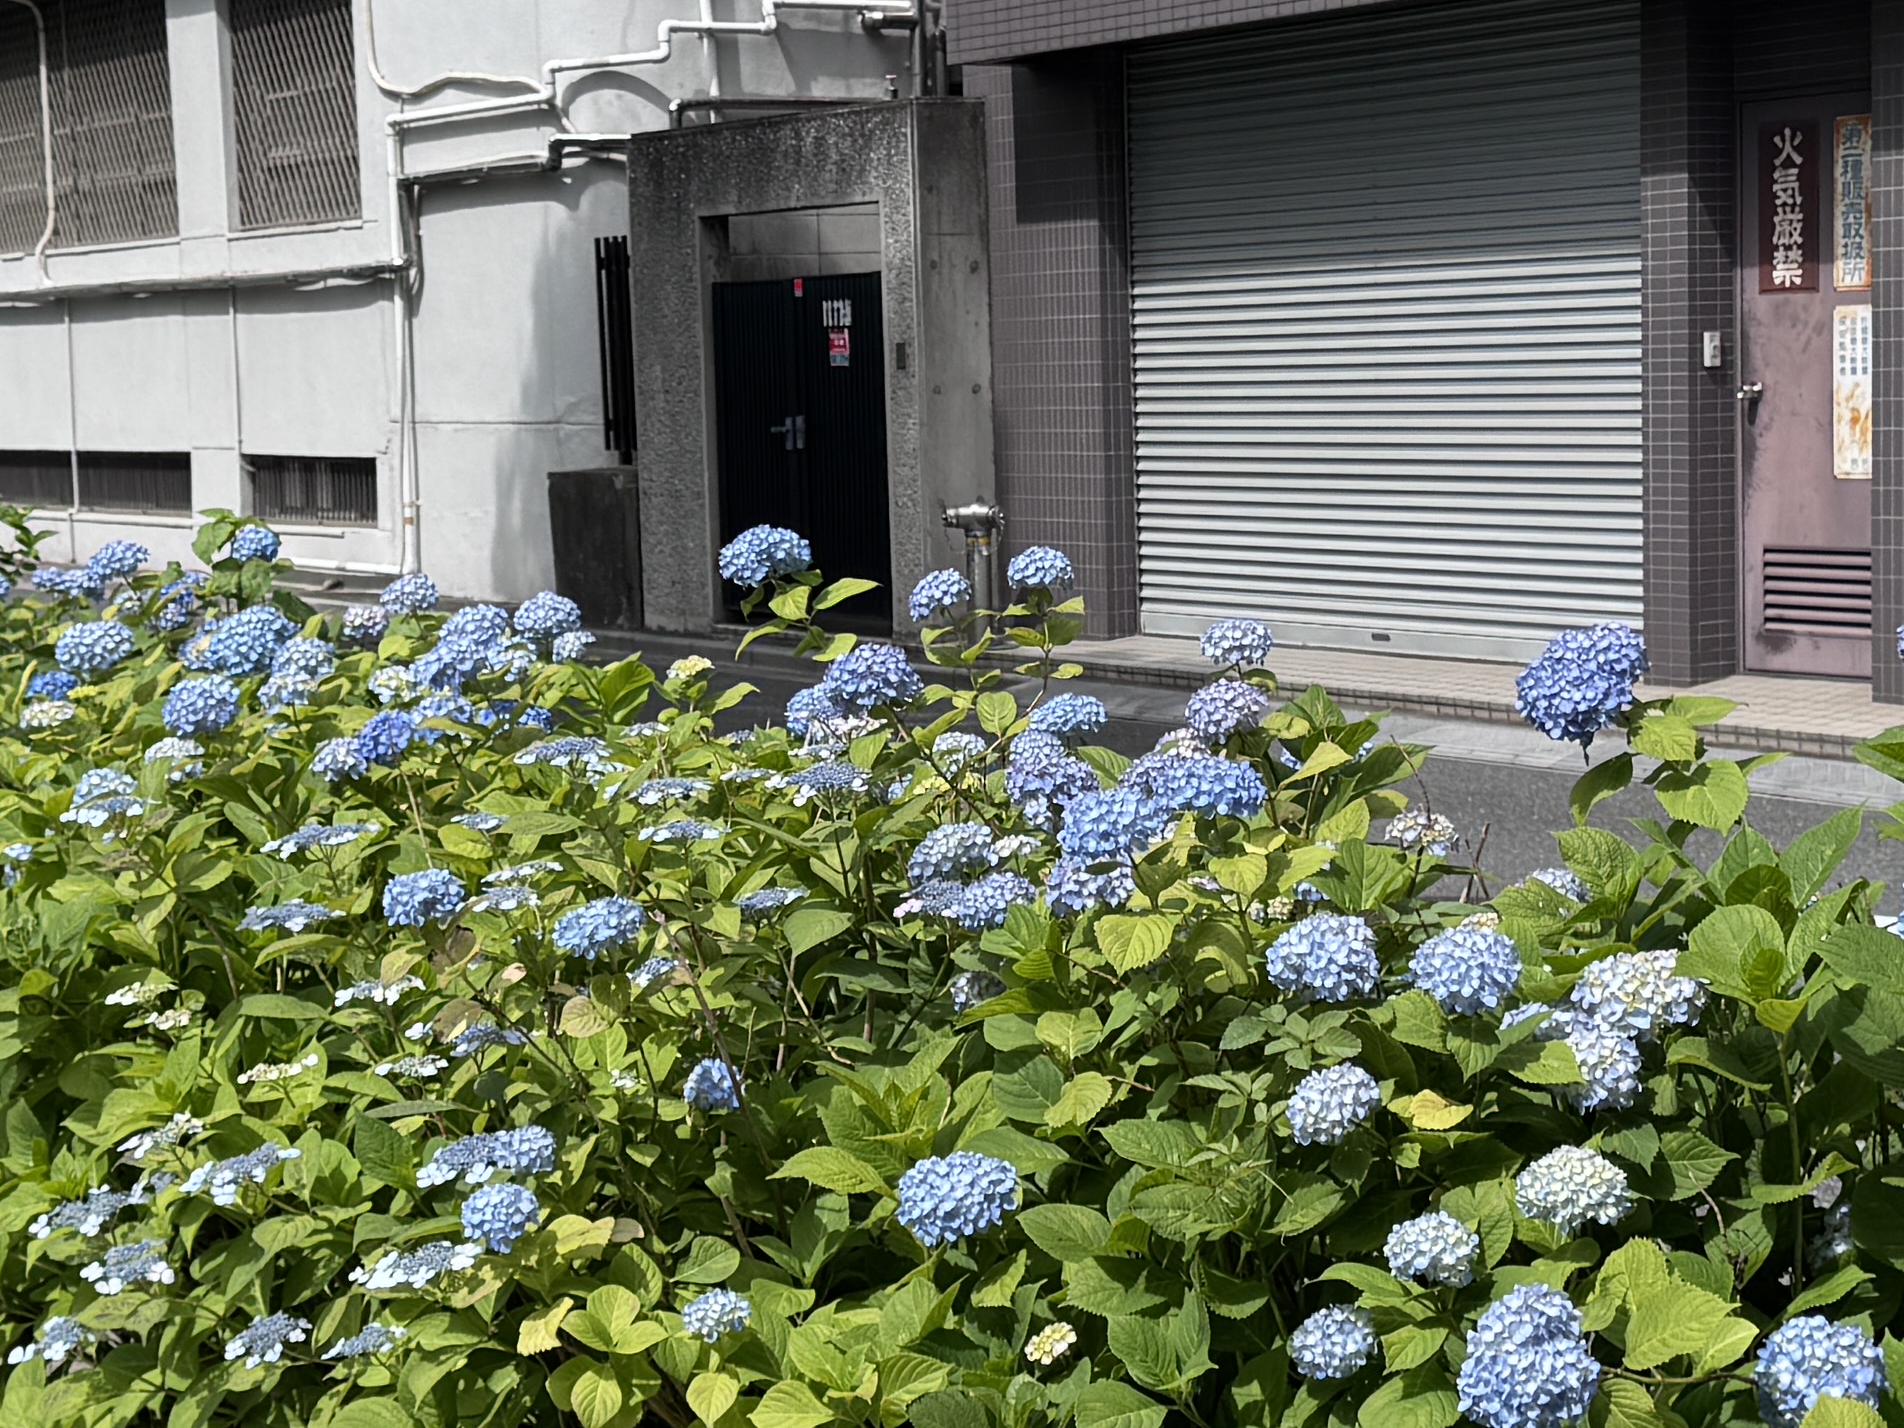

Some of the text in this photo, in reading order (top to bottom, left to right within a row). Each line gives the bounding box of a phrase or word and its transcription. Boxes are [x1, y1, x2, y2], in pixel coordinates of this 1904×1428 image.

[1772, 127, 1803, 288] 火気厳禁
[1841, 124, 1865, 283] 第二種販売取扱所
